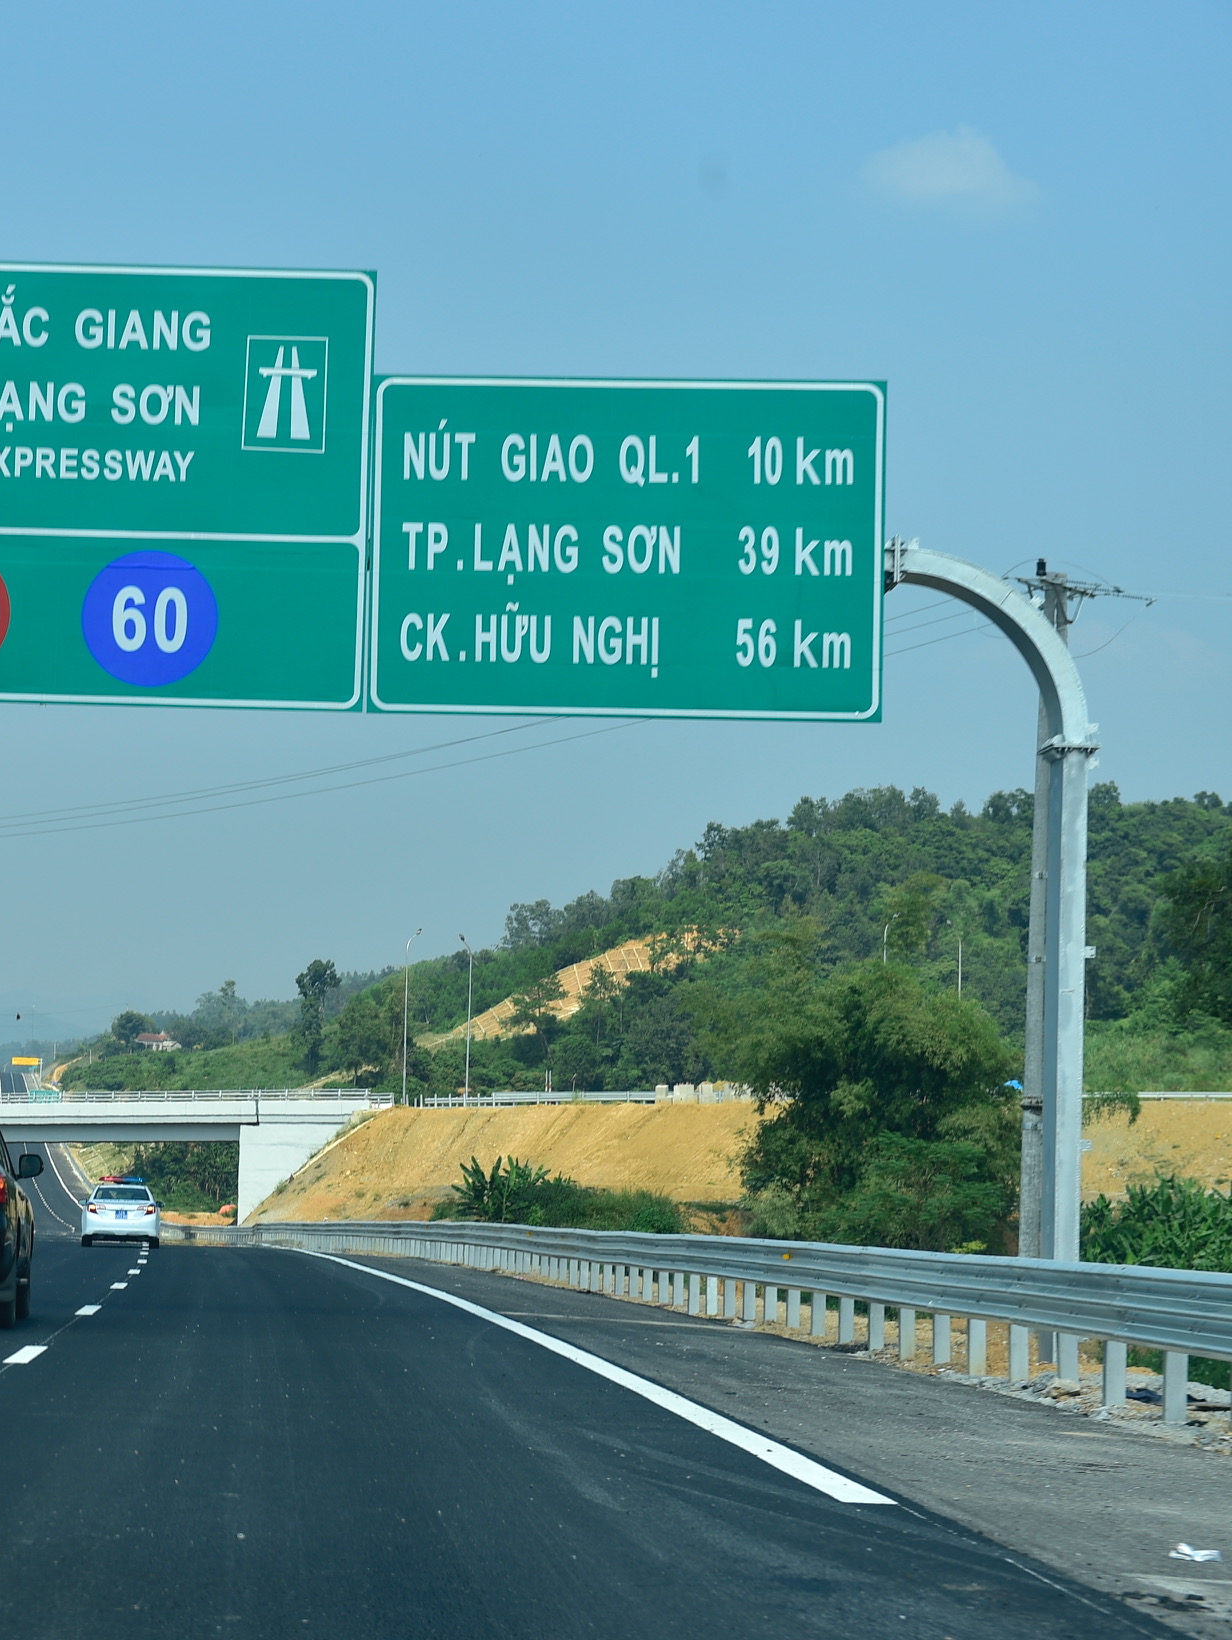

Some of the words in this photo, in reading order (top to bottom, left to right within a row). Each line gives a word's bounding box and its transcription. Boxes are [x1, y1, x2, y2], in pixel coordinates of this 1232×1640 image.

[75, 309, 210, 351] GIANG
[111, 384, 199, 425] SƠN
[404, 419, 475, 480] NÚT
[502, 434, 593, 482] GIAO
[620, 436, 698, 486] QL.1
[748, 437, 782, 485] 10
[797, 437, 853, 484] km
[403, 523, 578, 584] TP.LẠNG
[603, 525, 680, 573] SƠN
[739, 526, 779, 574] 39
[795, 528, 852, 576] km
[113, 586, 187, 653] 60
[573, 616, 658, 677] NGHỊ
[737, 619, 776, 667] 56
[794, 620, 850, 668] km
